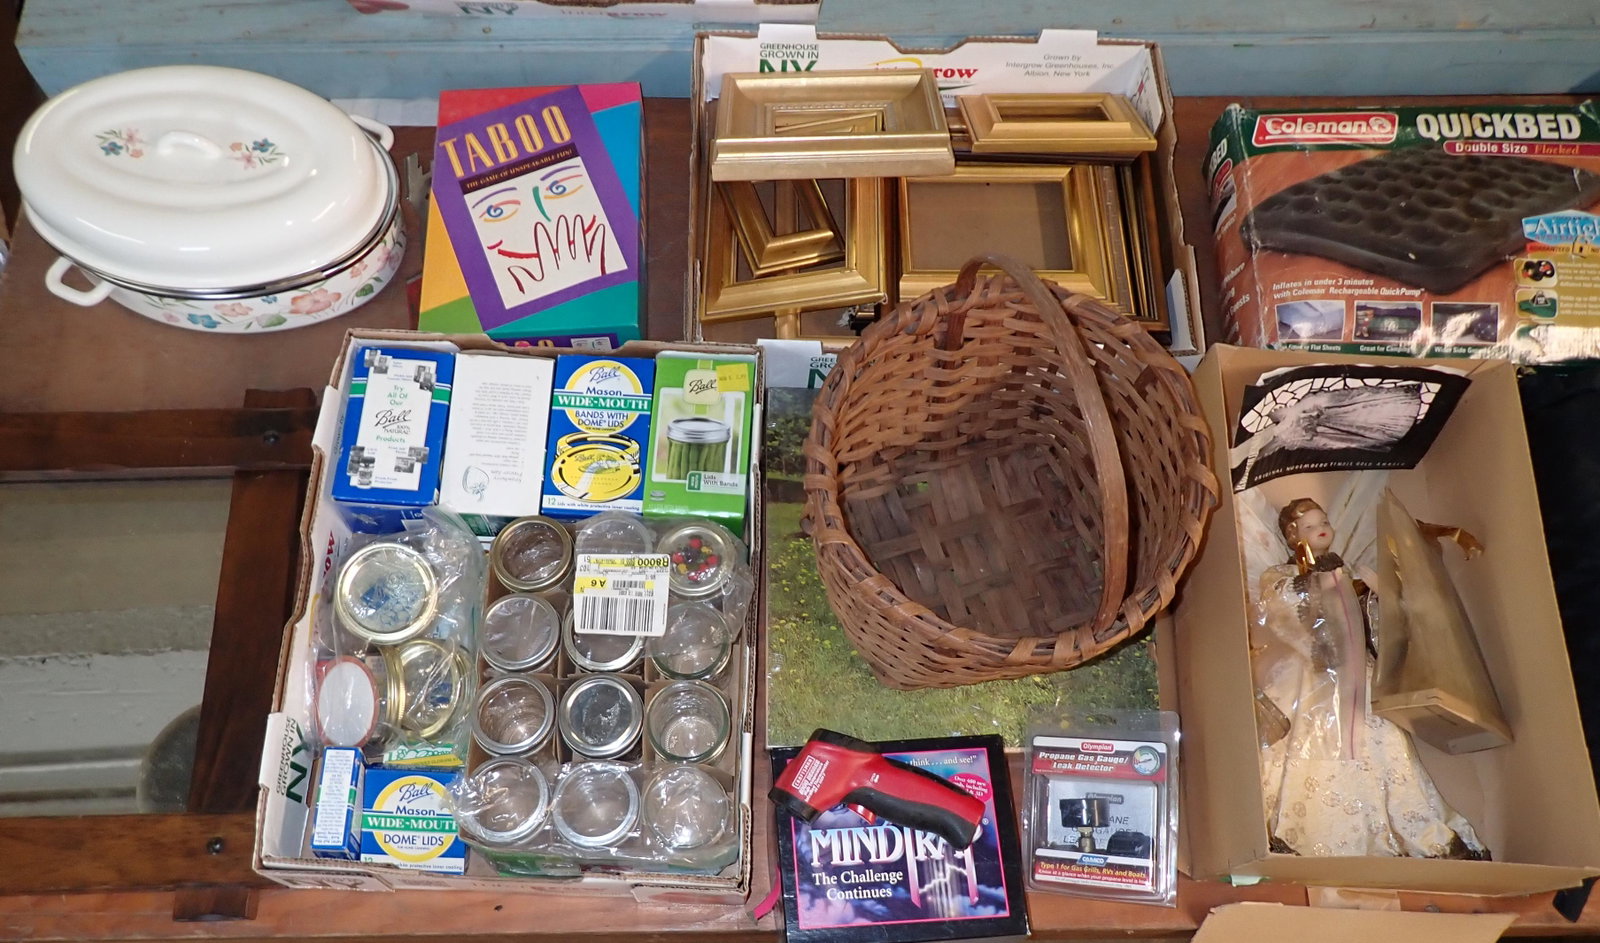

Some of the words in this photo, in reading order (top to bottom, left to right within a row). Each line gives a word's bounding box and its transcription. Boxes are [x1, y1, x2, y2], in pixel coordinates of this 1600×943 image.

[759, 42, 819, 51] GREENHOUSE
[759, 50, 805, 59] GROWN
[807, 51, 819, 59] IN
[1072, 54, 1082, 62] by
[1005, 61, 1042, 70] Intergrow
[1265, 117, 1367, 135] Coleman
[1416, 112, 1582, 141] QUICKBED
[439, 105, 573, 179] TABOO
[1455, 142, 1498, 153] Double
[1502, 143, 1529, 154] Size
[465, 180, 479, 189] THE
[480, 174, 499, 184] GAME
[556, 149, 574, 160] FUN!
[1272, 280, 1302, 291] Inflates
[1304, 278, 1313, 286] in
[1313, 277, 1336, 286] under
[1337, 278, 1343, 286] 3
[1343, 278, 1375, 286] minutes
[1272, 290, 1291, 300] with
[1292, 287, 1326, 297] Coleman
[1329, 286, 1379, 296] Rechargeable
[1360, 344, 1376, 352] Great
[589, 365, 622, 384] Ball
[393, 384, 404, 392] Try
[585, 386, 622, 396] Mason
[689, 378, 717, 395] Ball
[557, 395, 648, 410] WIDE-MOUTH
[374, 408, 412, 428] Ball
[575, 410, 605, 419] BANDS
[606, 412, 629, 420] WITH
[376, 434, 406, 444] Products
[547, 497, 556, 505] 12
[590, 579, 598, 587] 6
[599, 579, 607, 587] A
[1082, 743, 1113, 752] Olympian
[276, 715, 291, 795] GREENHOUSE
[280, 737, 293, 796] GROWN
[289, 719, 297, 734] IN
[910, 758, 930, 766] think
[943, 756, 958, 765] and
[1038, 751, 1076, 761] Propane
[1077, 753, 1095, 762] Gas
[1096, 755, 1129, 765] Gauge/
[286, 722, 309, 804] NY
[1052, 761, 1073, 770] Leak
[1074, 763, 1115, 772] Detector
[398, 782, 434, 804] Ball
[395, 805, 436, 816] Mason
[422, 835, 444, 847] LIDS
[1040, 861, 1055, 870] Type
[1084, 866, 1101, 874] Grills,
[1128, 870, 1147, 879] Boats
[812, 872, 838, 886] The
[840, 869, 904, 885] Challenge
[1101, 875, 1122, 883] propane
[826, 886, 893, 901] Continues
